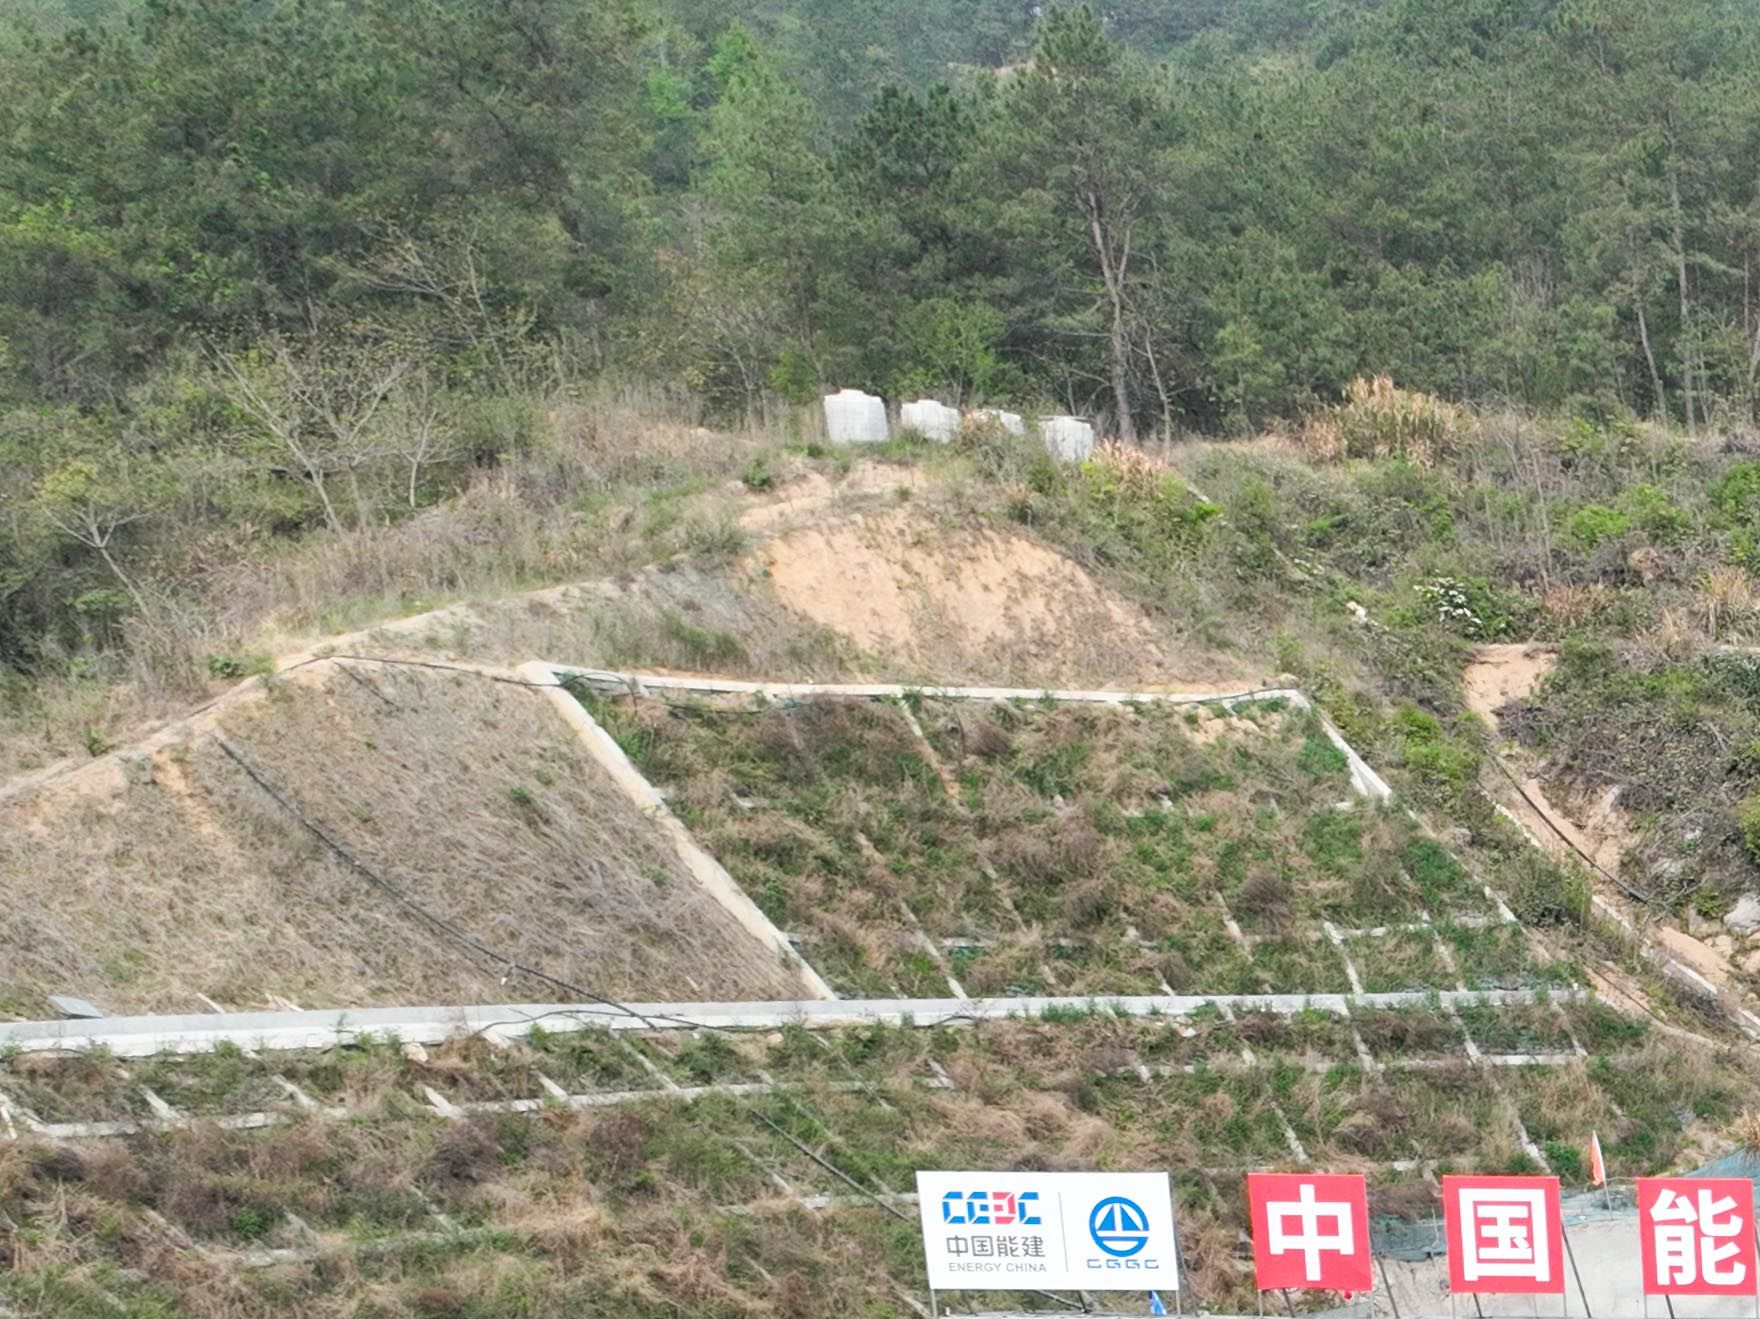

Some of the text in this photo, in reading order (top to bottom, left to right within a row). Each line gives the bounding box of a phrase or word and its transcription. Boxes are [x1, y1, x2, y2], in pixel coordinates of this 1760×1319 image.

[946, 1234, 1046, 1258] 中国能建
[949, 1262, 1047, 1273] ENERGY CHINA
